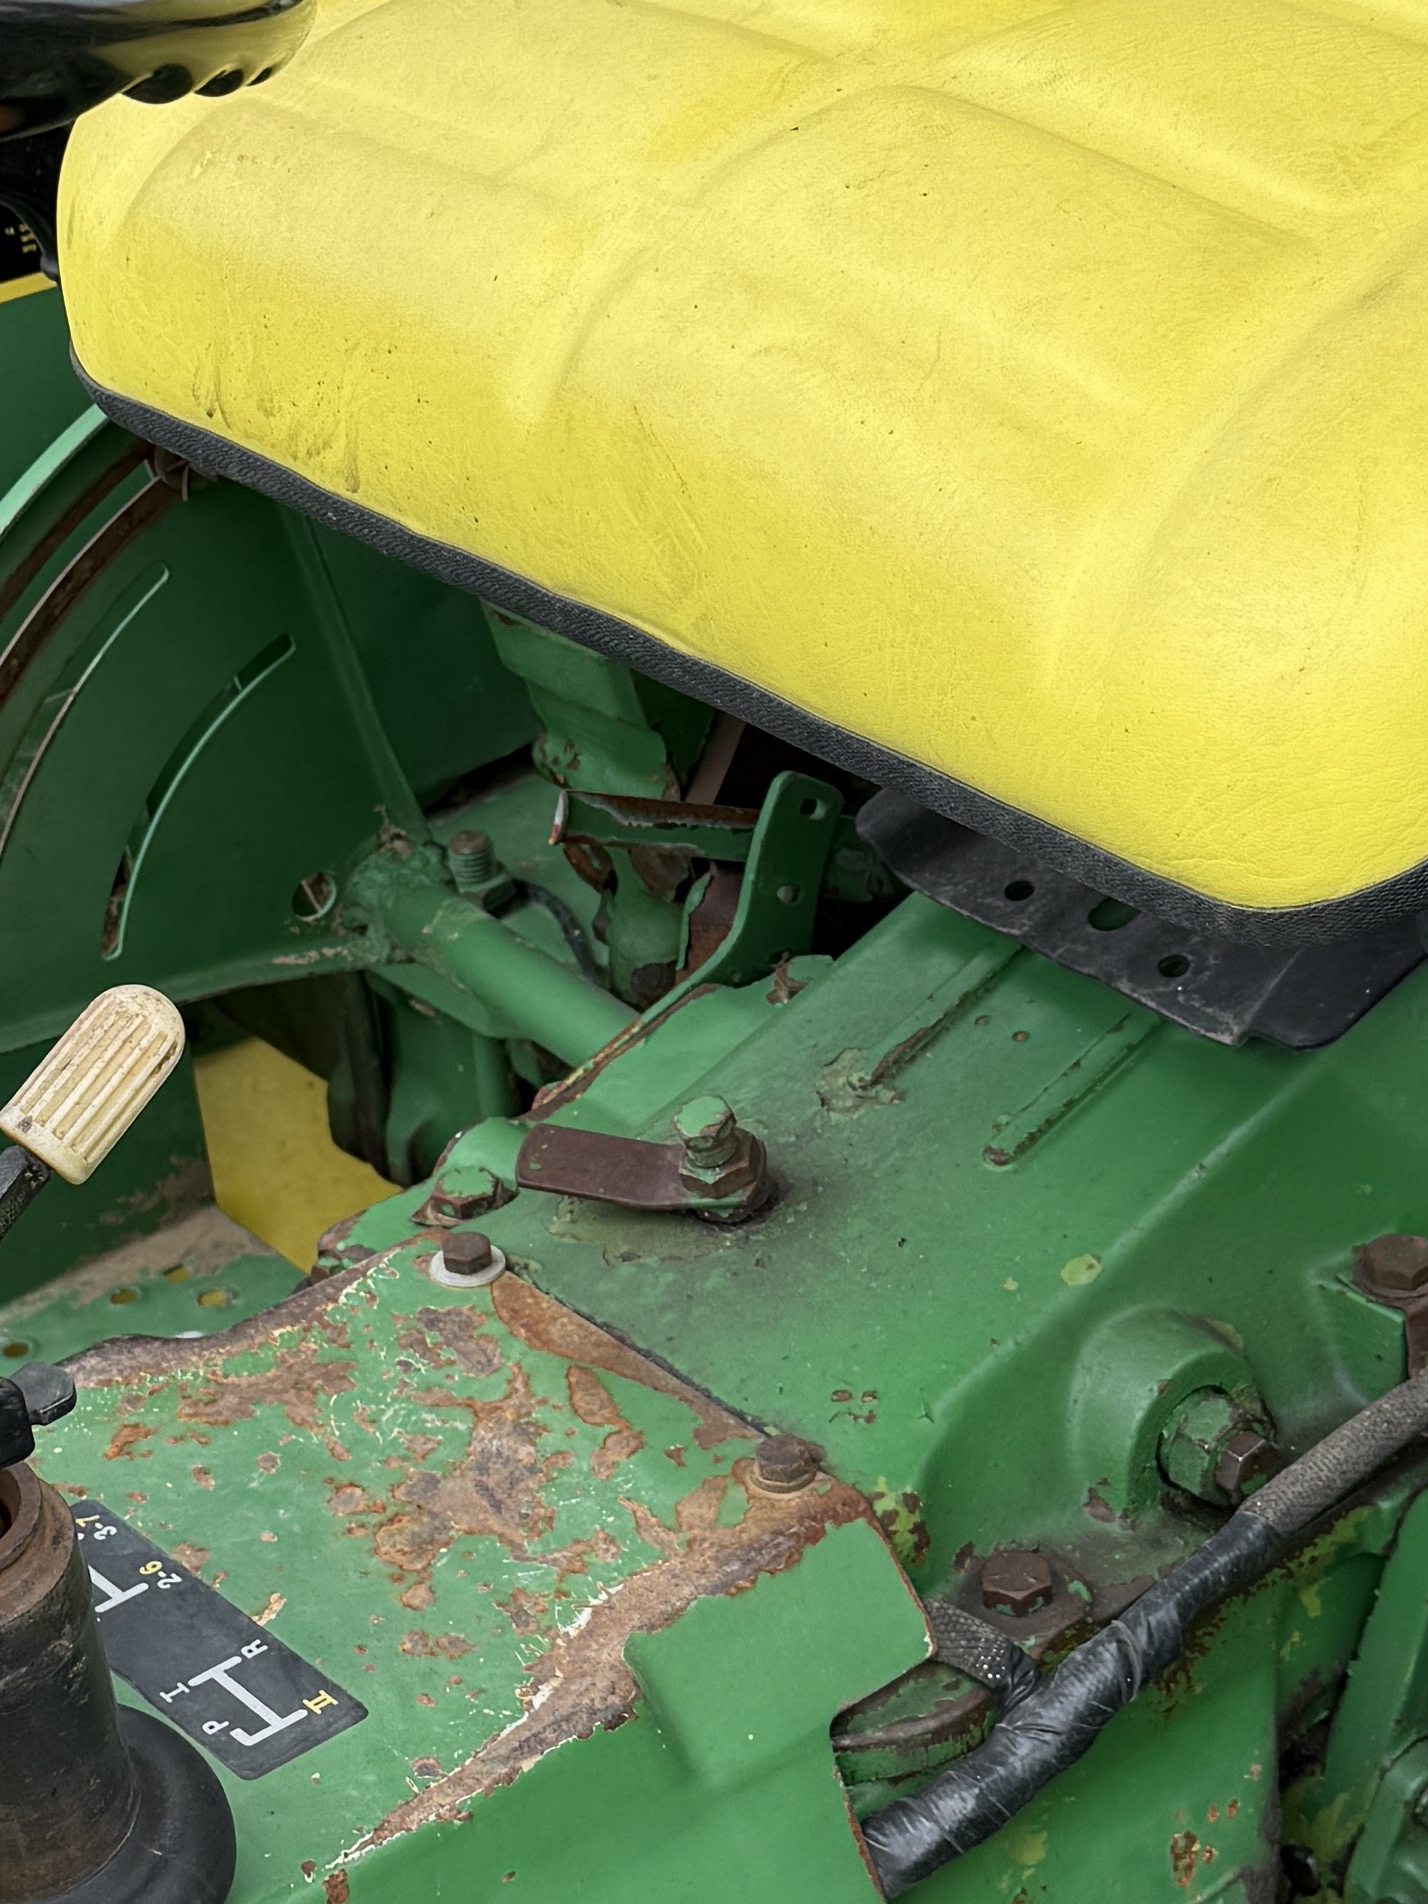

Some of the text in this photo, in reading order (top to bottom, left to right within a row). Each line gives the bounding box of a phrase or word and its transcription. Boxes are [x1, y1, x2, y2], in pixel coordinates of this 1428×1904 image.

[138, 1559, 184, 1590] 2-6
[240, 1638, 269, 1660] R
[201, 1719, 230, 1736] P
